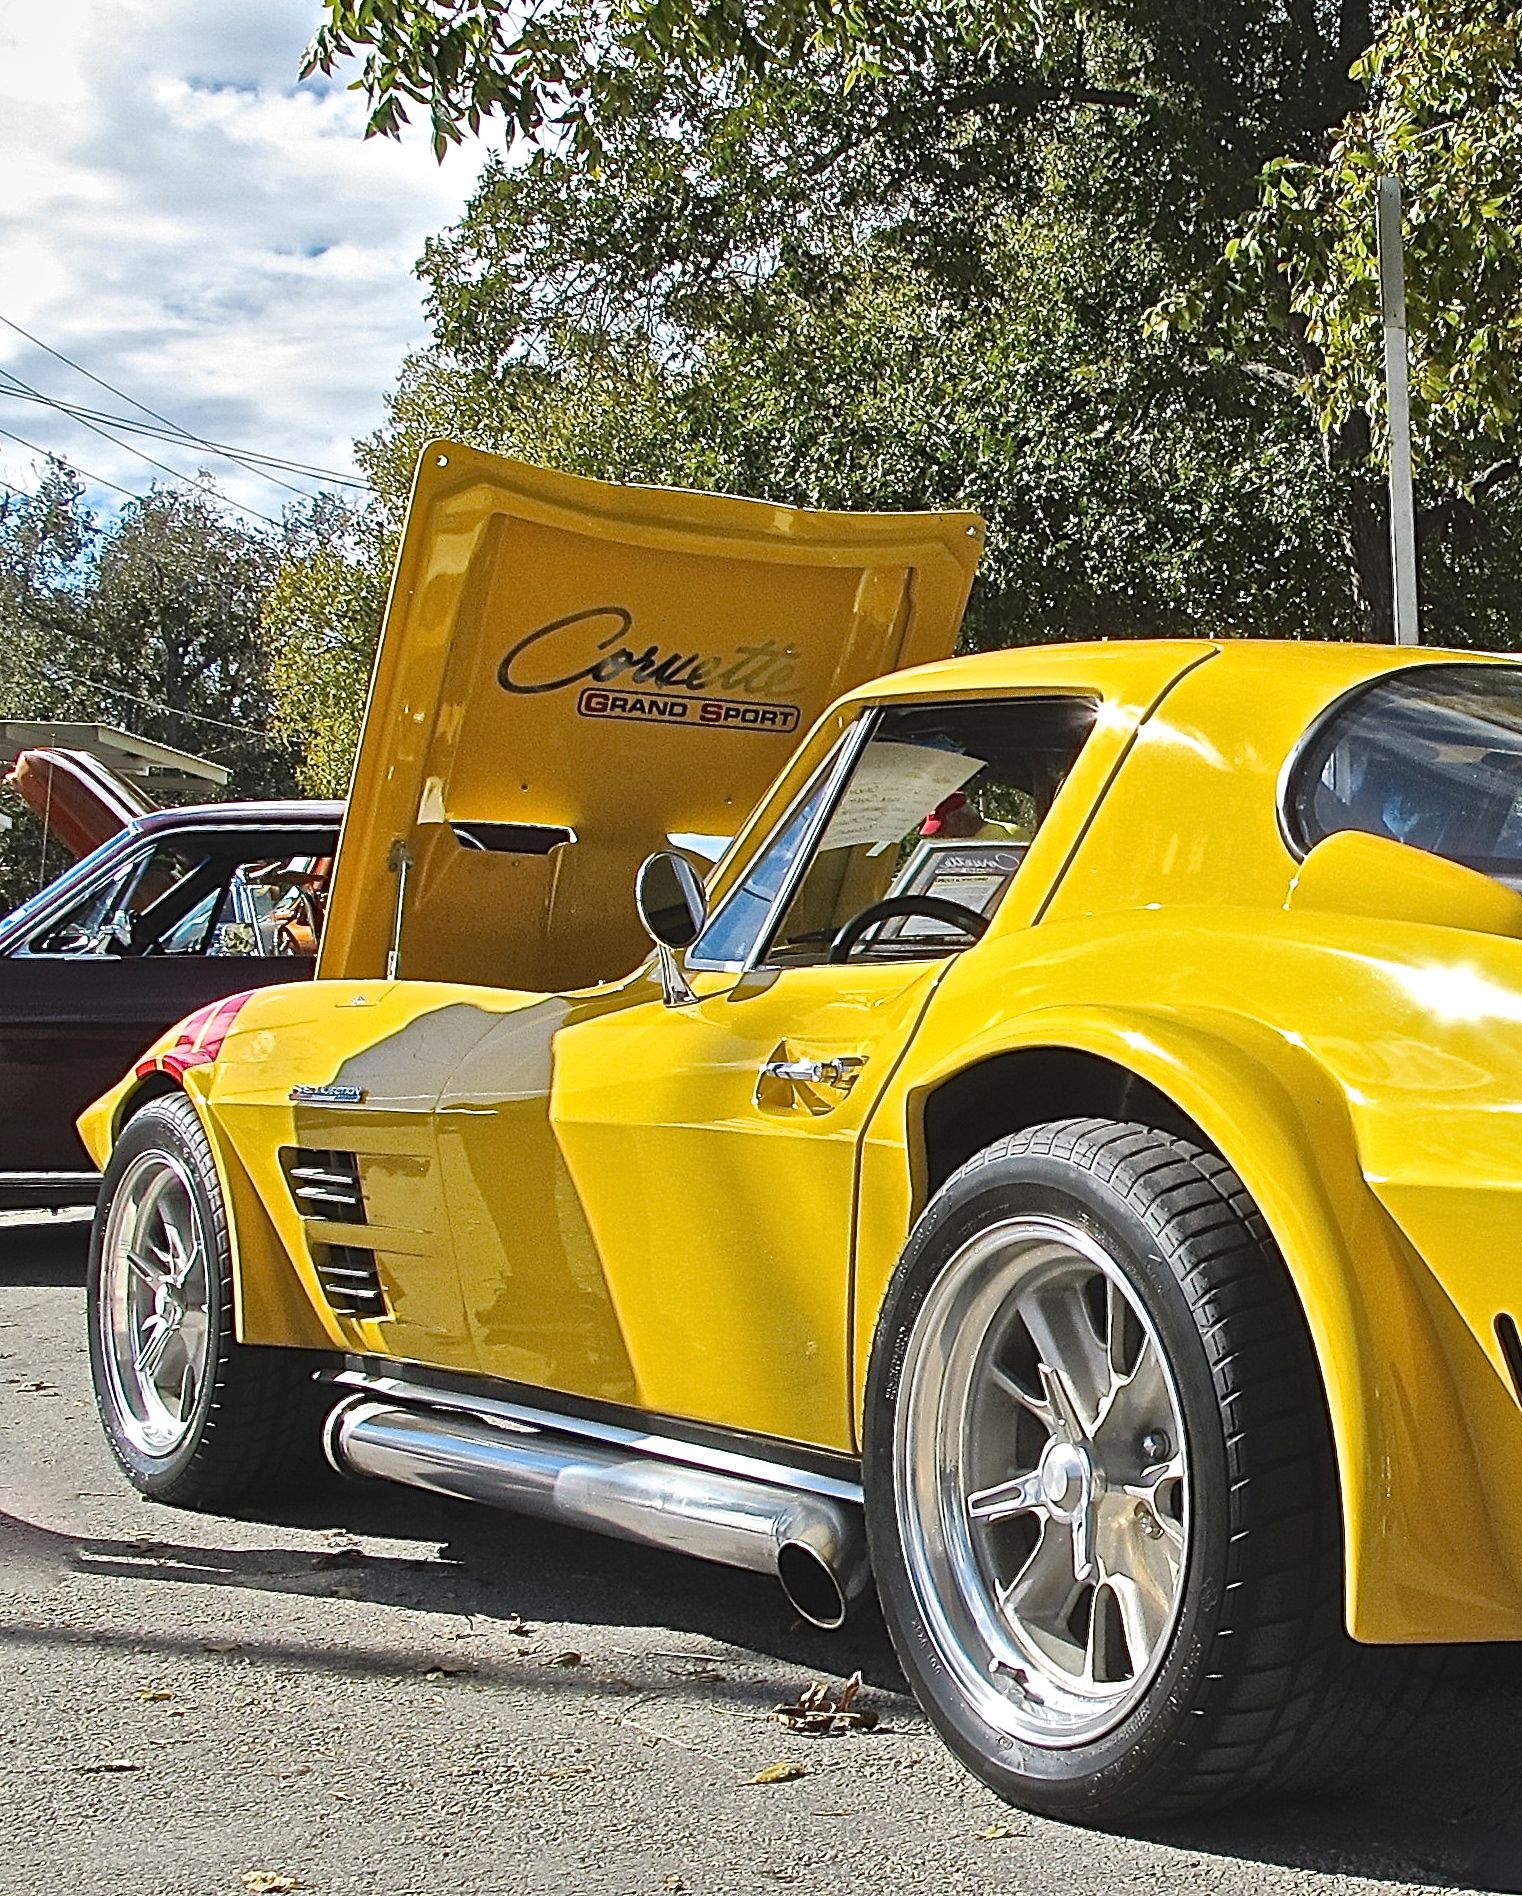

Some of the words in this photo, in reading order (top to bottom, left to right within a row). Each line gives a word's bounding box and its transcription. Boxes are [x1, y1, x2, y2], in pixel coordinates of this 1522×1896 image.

[497, 606, 805, 698] Corvette
[584, 692, 689, 718] GRAND
[700, 702, 795, 727] SPORT
